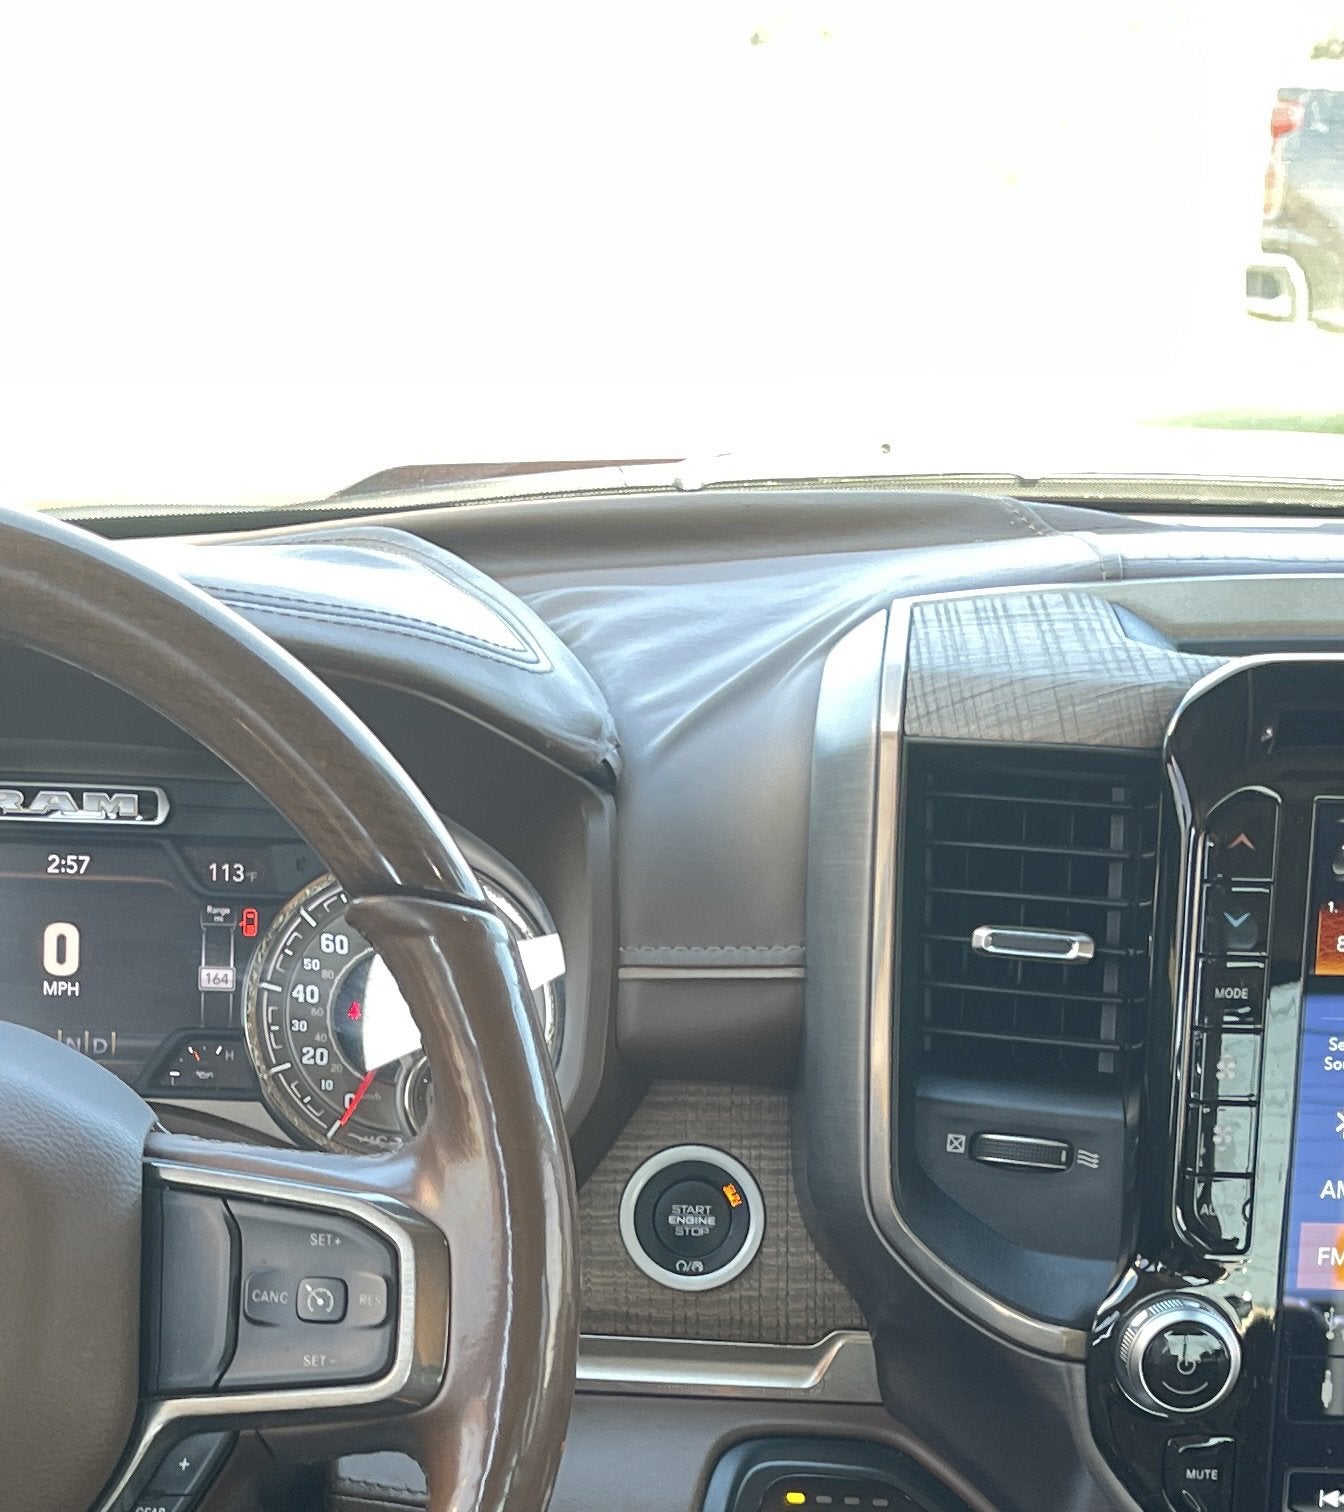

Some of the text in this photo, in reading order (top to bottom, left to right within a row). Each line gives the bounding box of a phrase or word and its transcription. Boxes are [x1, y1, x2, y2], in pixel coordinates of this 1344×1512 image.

[47, 854, 90, 875] 2:57
[1328, 901, 1339, 914] 1.
[43, 922, 80, 976] 0
[320, 934, 348, 954] 60
[303, 958, 320, 971] 50
[206, 972, 229, 985] 164
[43, 981, 80, 997] MPH
[292, 984, 319, 1004] 40
[1215, 988, 1248, 1000] MODE
[291, 1020, 307, 1032] 30
[302, 1047, 328, 1065] 20
[320, 1079, 333, 1091] 10
[671, 1204, 712, 1215] START
[668, 1215, 716, 1226] ENGINE
[674, 1226, 709, 1237] STOP
[252, 1291, 288, 1305] CANC
[359, 1294, 381, 1306] RES
[1186, 1469, 1218, 1481] MUTE
